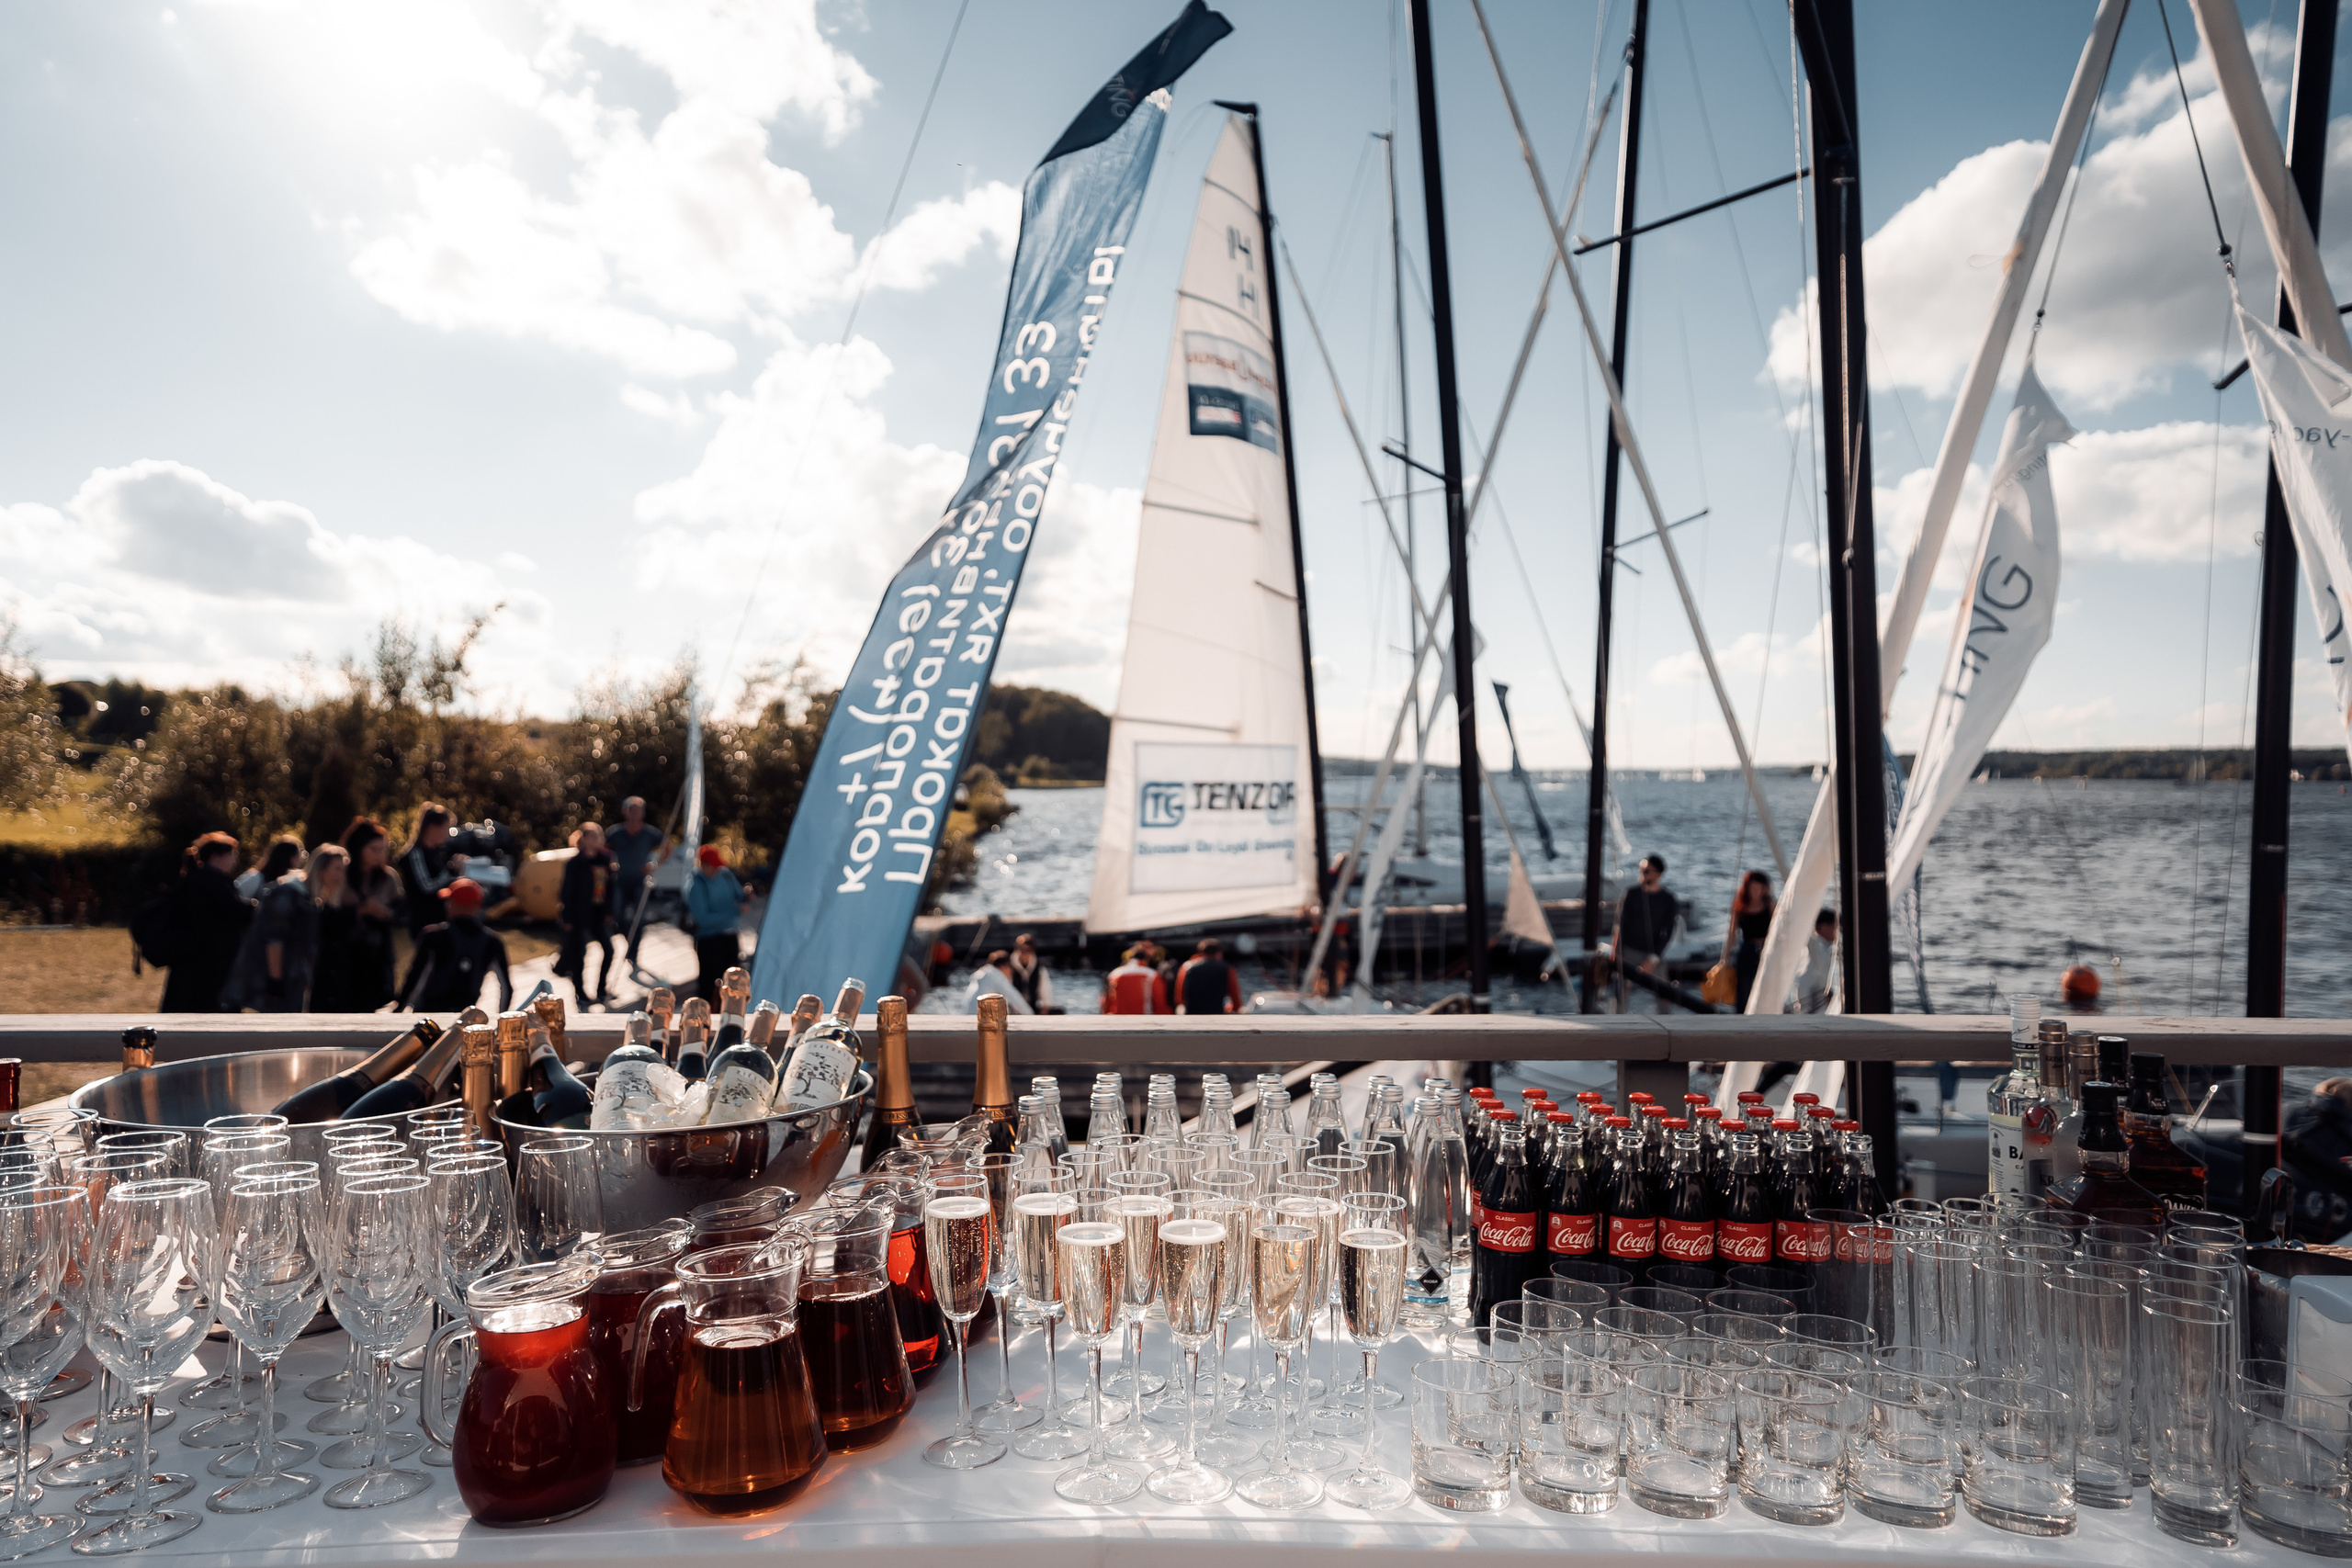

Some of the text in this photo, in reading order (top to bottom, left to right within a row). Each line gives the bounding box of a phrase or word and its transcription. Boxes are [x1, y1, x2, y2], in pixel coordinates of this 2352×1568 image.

[1495, 1214, 1517, 1223] CLASSIC
[1726, 1224, 1748, 1233] CLASSIC
[1479, 1221, 1533, 1248] Coca-Cola
